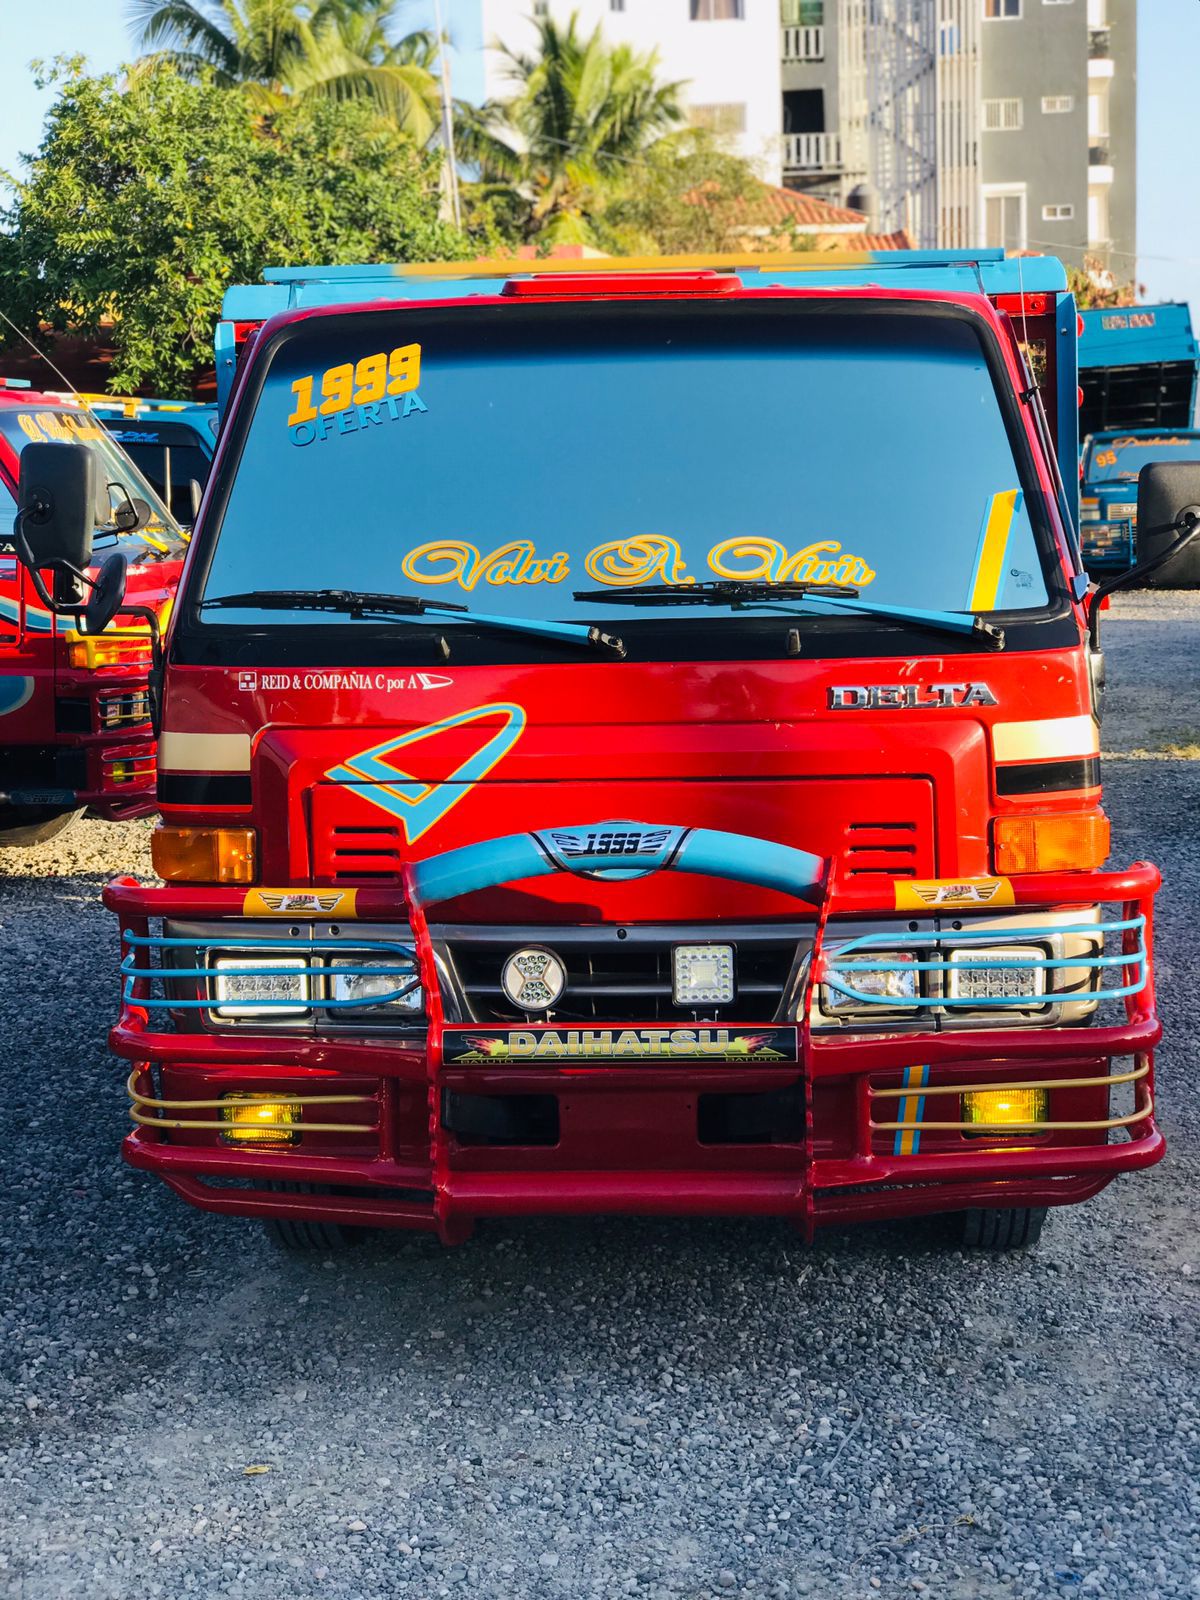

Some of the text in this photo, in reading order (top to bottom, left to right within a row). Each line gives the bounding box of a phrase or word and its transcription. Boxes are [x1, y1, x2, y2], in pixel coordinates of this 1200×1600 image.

[288, 343, 421, 427] 1999
[289, 391, 428, 447] OFERTA
[401, 540, 570, 592] Volvi
[708, 536, 875, 586] Vivir
[261, 672, 417, 692] REID & COMPAÑIA C por A
[826, 682, 999, 710] DELTA
[583, 833, 641, 854] 1999
[508, 1030, 729, 1056] DAIHATSU
